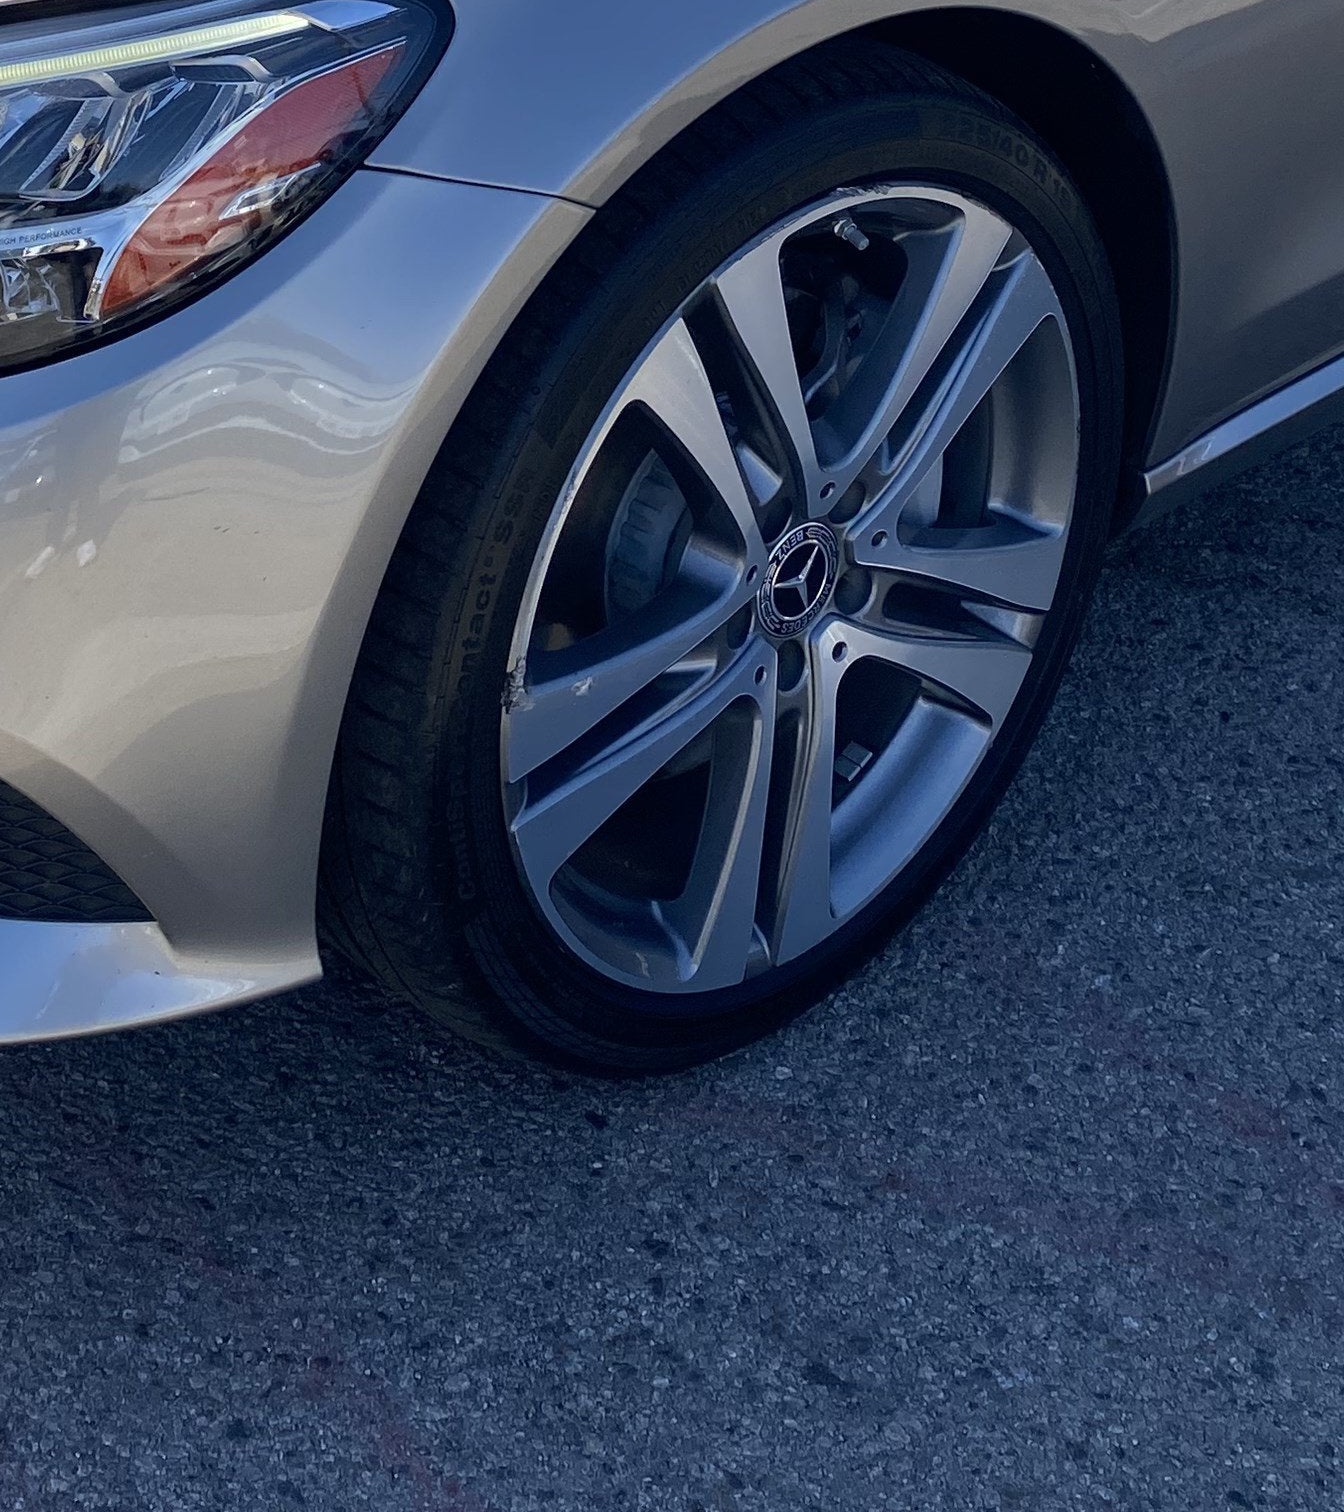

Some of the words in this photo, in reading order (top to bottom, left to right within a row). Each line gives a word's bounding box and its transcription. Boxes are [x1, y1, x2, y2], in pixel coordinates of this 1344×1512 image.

[19, 226, 82, 244] PERFORMANCE
[775, 529, 804, 561] BENZ
[781, 583, 832, 634] MERCEDES
